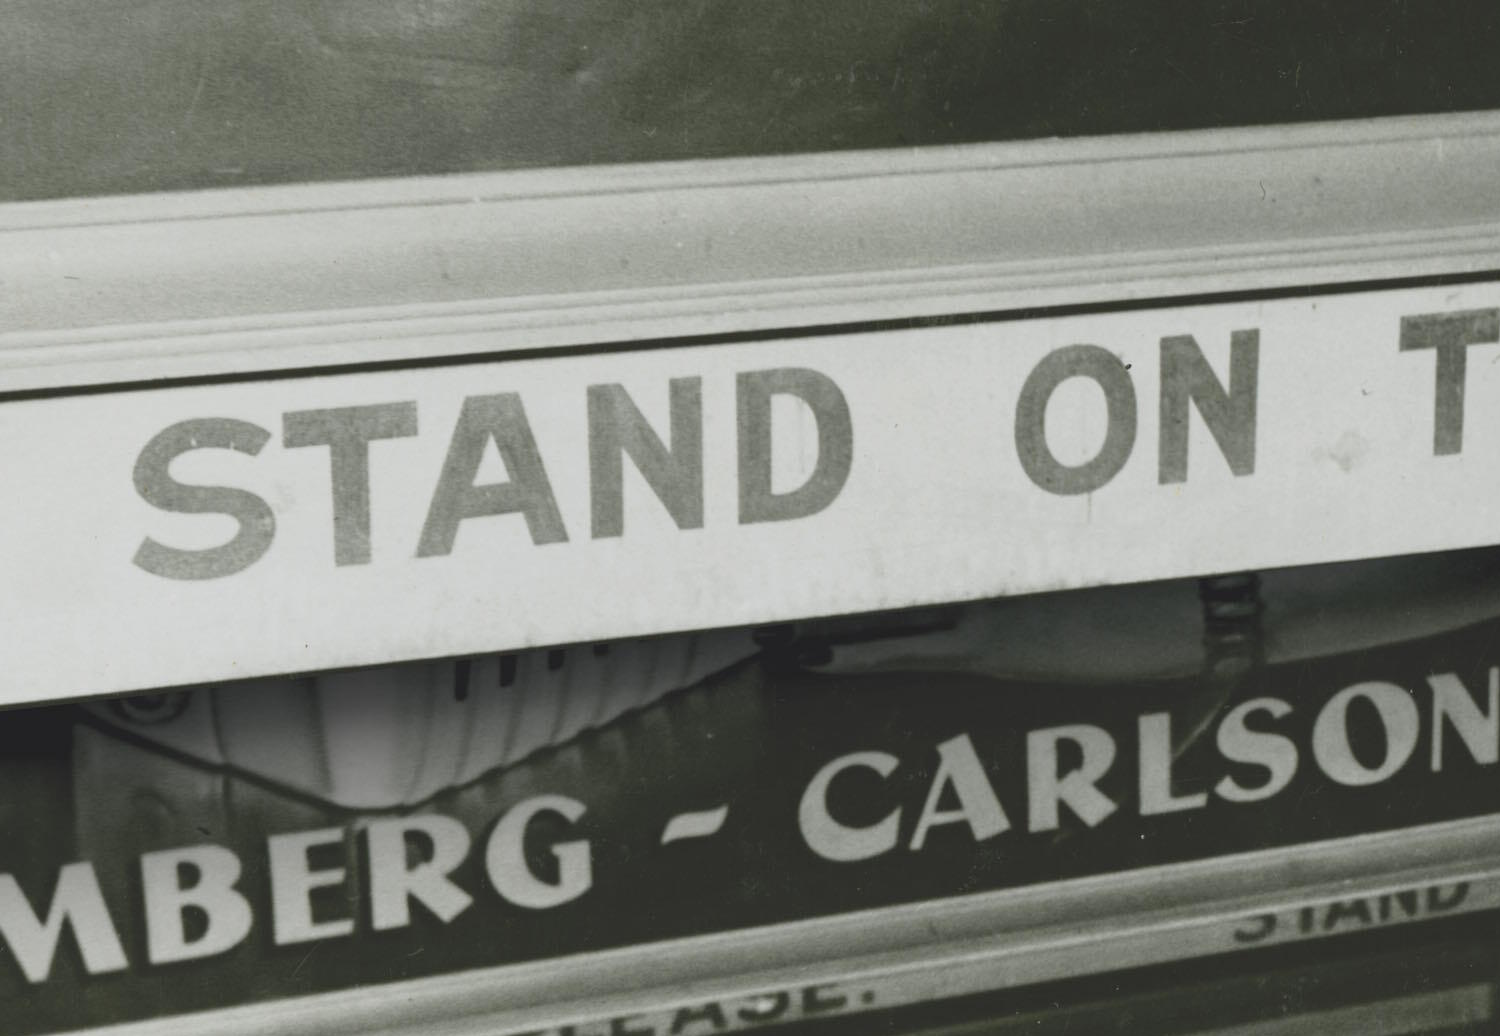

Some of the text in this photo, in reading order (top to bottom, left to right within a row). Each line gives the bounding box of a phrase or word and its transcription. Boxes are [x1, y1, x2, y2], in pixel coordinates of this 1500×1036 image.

[132, 366, 854, 581] STAND
[1014, 328, 1261, 496] ON
[0, 795, 593, 984] MBERG
